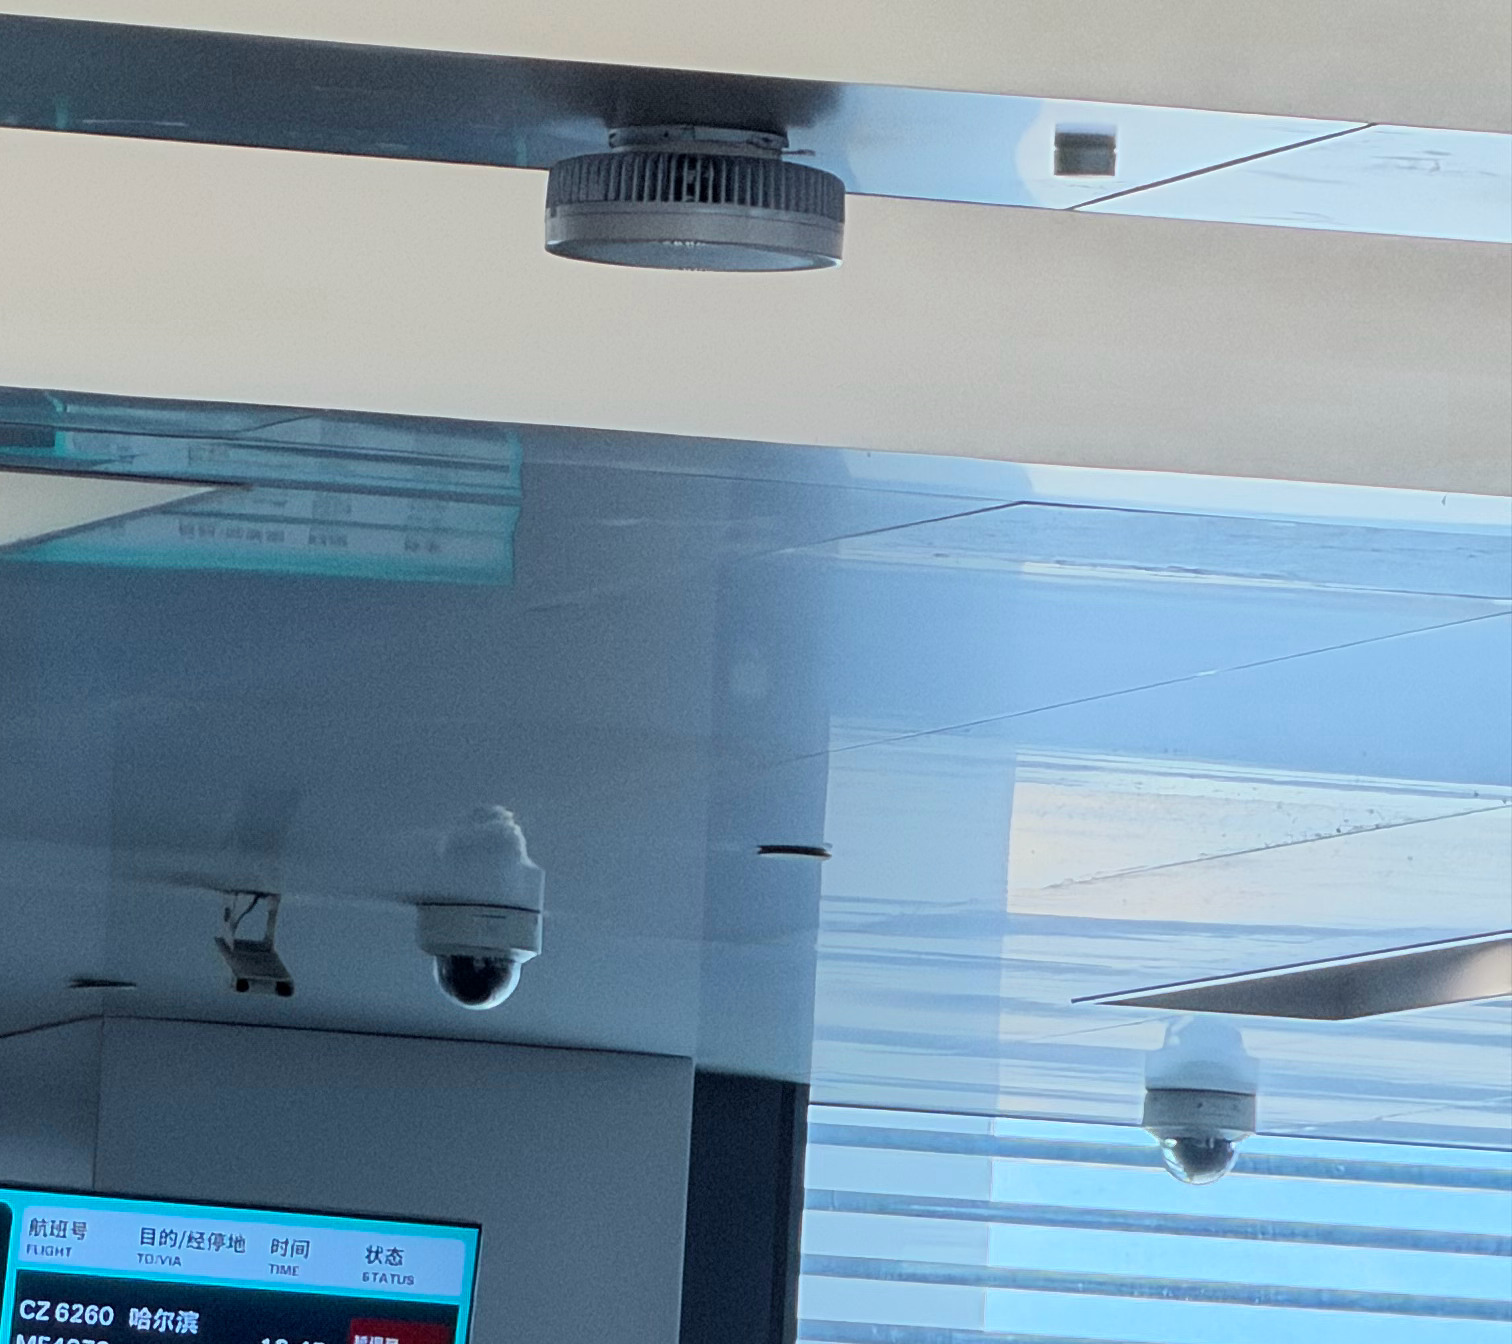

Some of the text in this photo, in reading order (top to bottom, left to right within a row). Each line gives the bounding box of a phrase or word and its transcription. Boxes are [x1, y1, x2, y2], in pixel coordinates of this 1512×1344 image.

[28, 1217, 89, 1242] 航班号
[138, 1227, 247, 1255] 目的/经停地
[25, 1244, 73, 1259] FLIGHT
[136, 1252, 182, 1268] TO/VIA
[270, 1237, 311, 1260] 时间
[365, 1244, 406, 1267] 状态
[268, 1262, 300, 1278] TIME
[361, 1271, 415, 1287] STATUS
[128, 1308, 200, 1335] 哈尔滨
